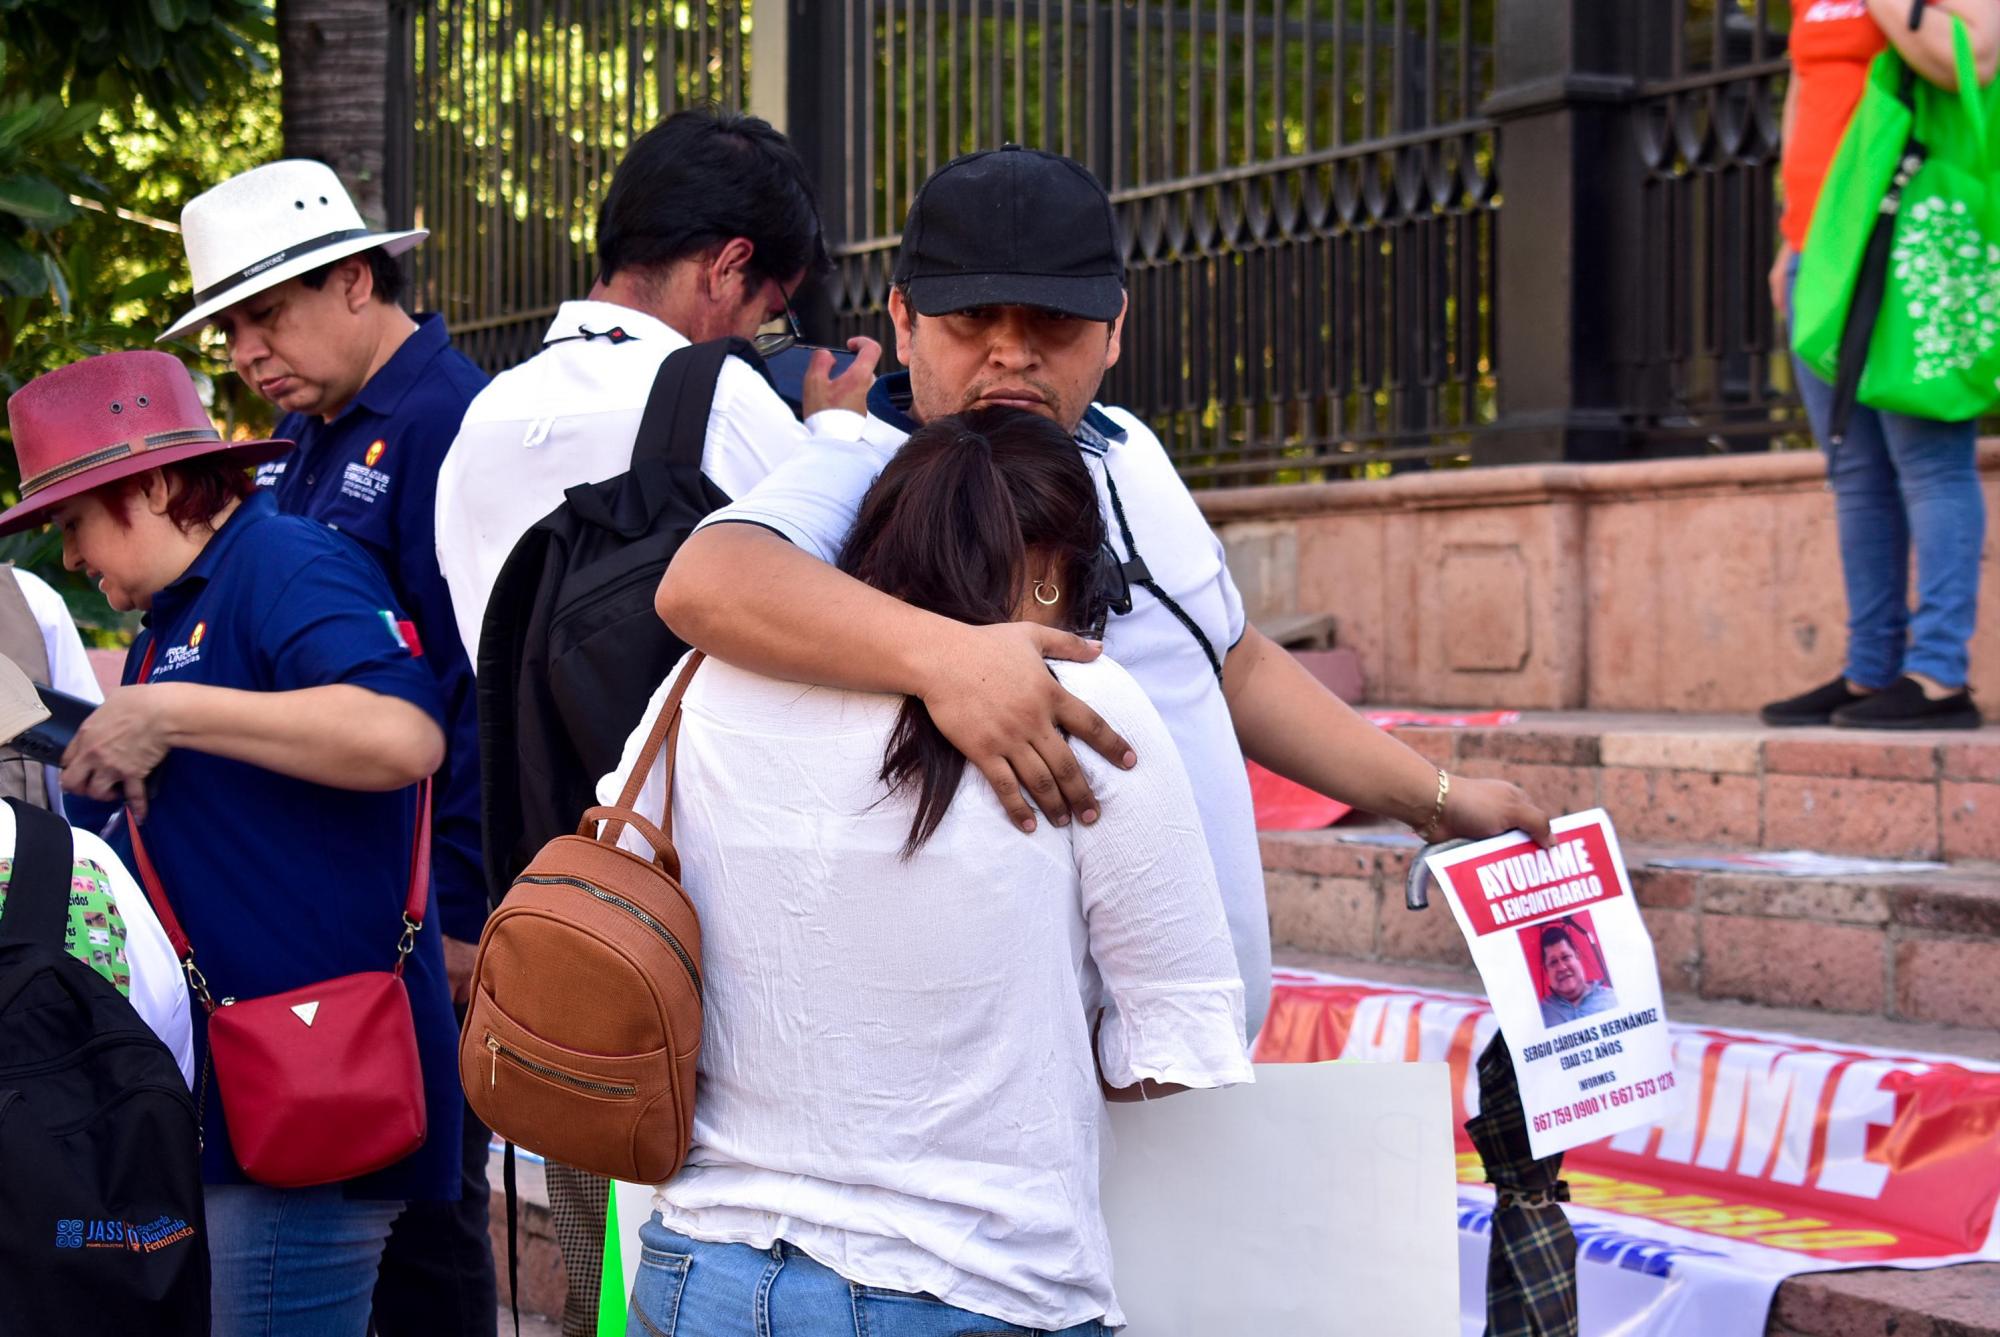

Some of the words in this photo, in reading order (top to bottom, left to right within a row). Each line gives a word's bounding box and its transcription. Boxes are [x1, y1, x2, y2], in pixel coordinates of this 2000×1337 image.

[1476, 838, 1595, 900] AYUDAME
[1490, 903, 1506, 926] A
[1503, 875, 1604, 922] ENCONTRARLO
[1522, 1040, 1553, 1063] SERGIO
[1599, 1007, 1659, 1038] HERNÁNDEZ
[1560, 1052, 1581, 1071] EDAD
[1581, 1048, 1595, 1064] 52
[1594, 1039, 1624, 1060] AÑOS
[1578, 1071, 1617, 1092] INFORMES
[1533, 1112, 1552, 1133] 667
[1552, 1105, 1573, 1126] 759
[1572, 1097, 1600, 1120] 0900
[1599, 1093, 1608, 1111] Y
[1609, 1085, 1634, 1107] 667
[1635, 1077, 1656, 1099] 573
[87, 1219, 124, 1241] JASS
[141, 1218, 187, 1245] Alquimia
[143, 1226, 195, 1253] Feminista
